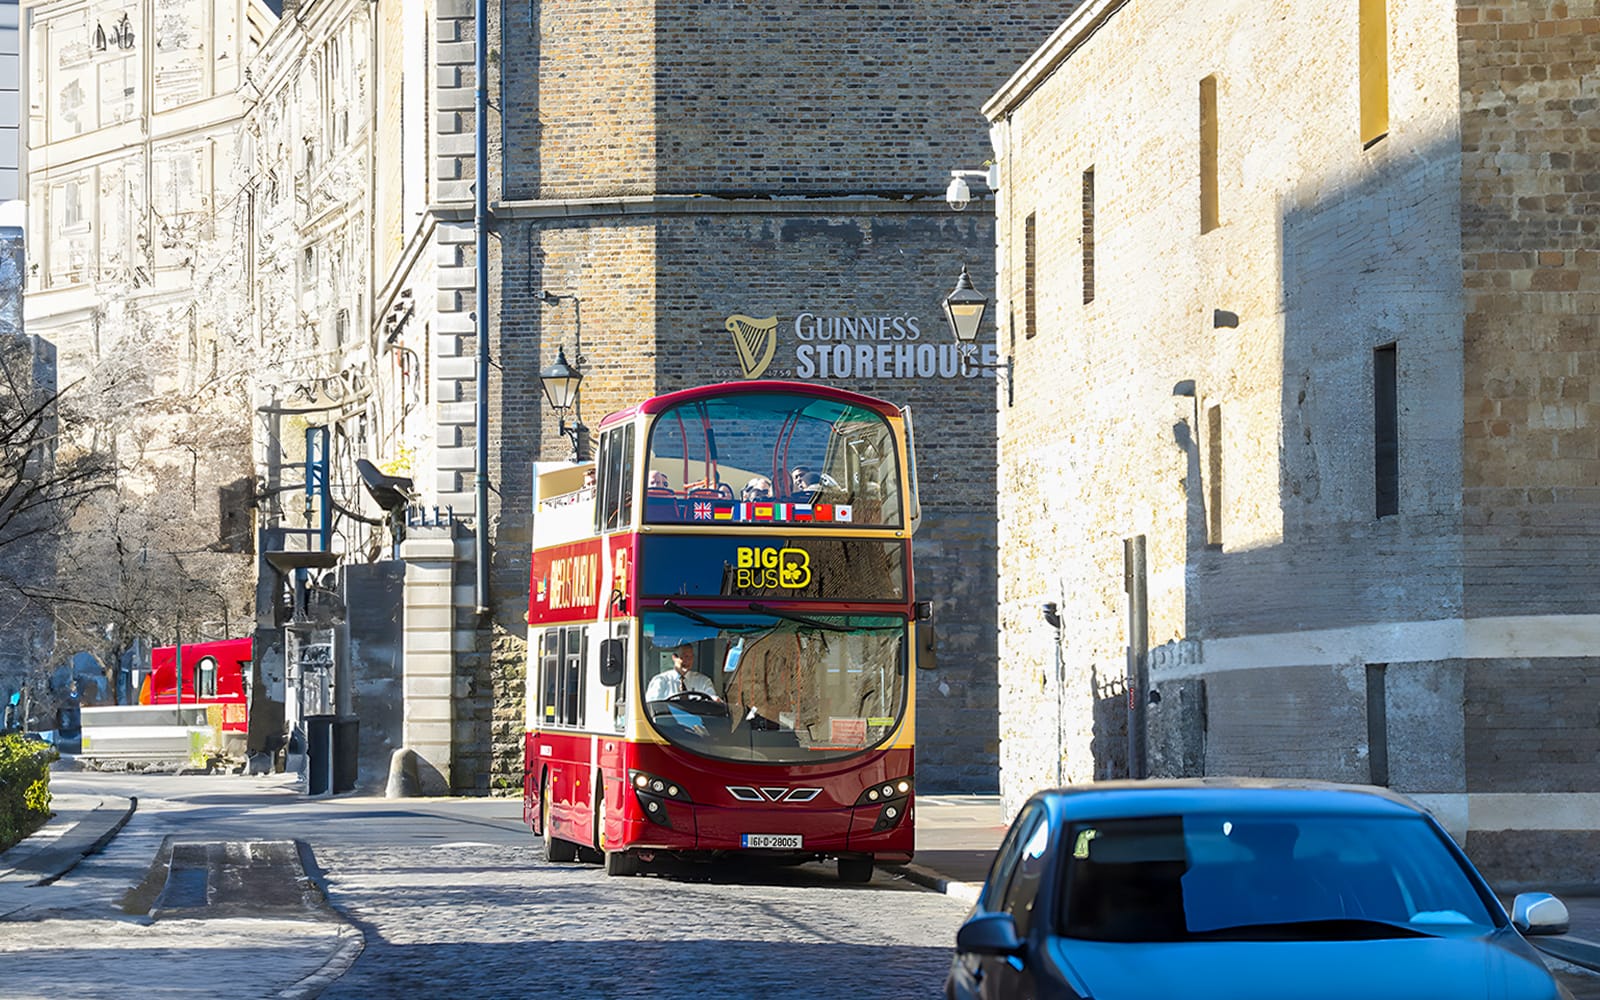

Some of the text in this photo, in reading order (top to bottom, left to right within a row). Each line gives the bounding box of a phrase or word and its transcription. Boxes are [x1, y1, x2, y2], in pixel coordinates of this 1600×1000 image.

[795, 312, 920, 340] GUINNESS
[796, 344, 997, 378] STOREHOUSE
[737, 547, 778, 568] BIG
[737, 569, 779, 588] BUS
